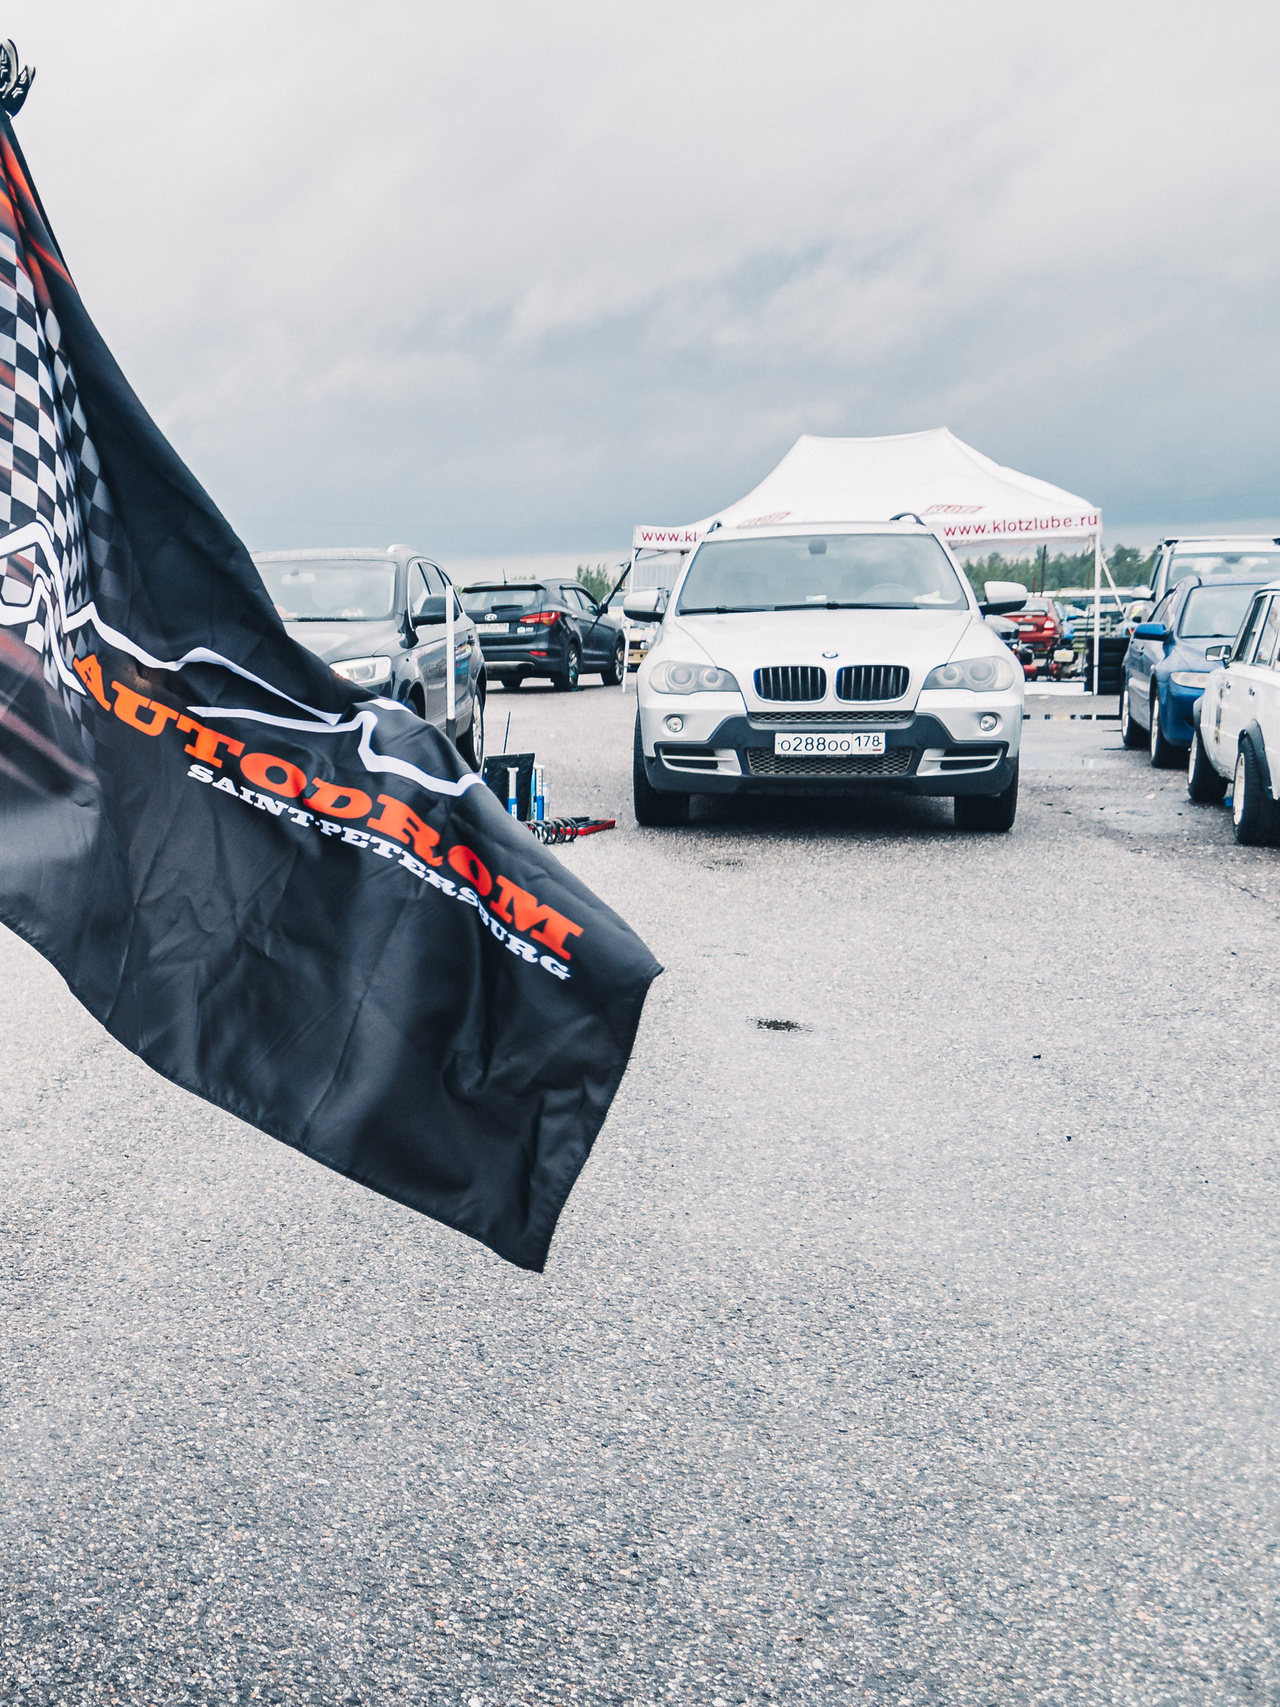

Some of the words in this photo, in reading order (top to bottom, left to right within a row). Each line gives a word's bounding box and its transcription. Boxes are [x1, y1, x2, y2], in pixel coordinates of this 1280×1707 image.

[943, 515, 1098, 537] www.klotzlube.ru
[641, 531, 699, 543] www.kl
[854, 735, 880, 748] 178
[73, 654, 584, 960] AUTODROM
